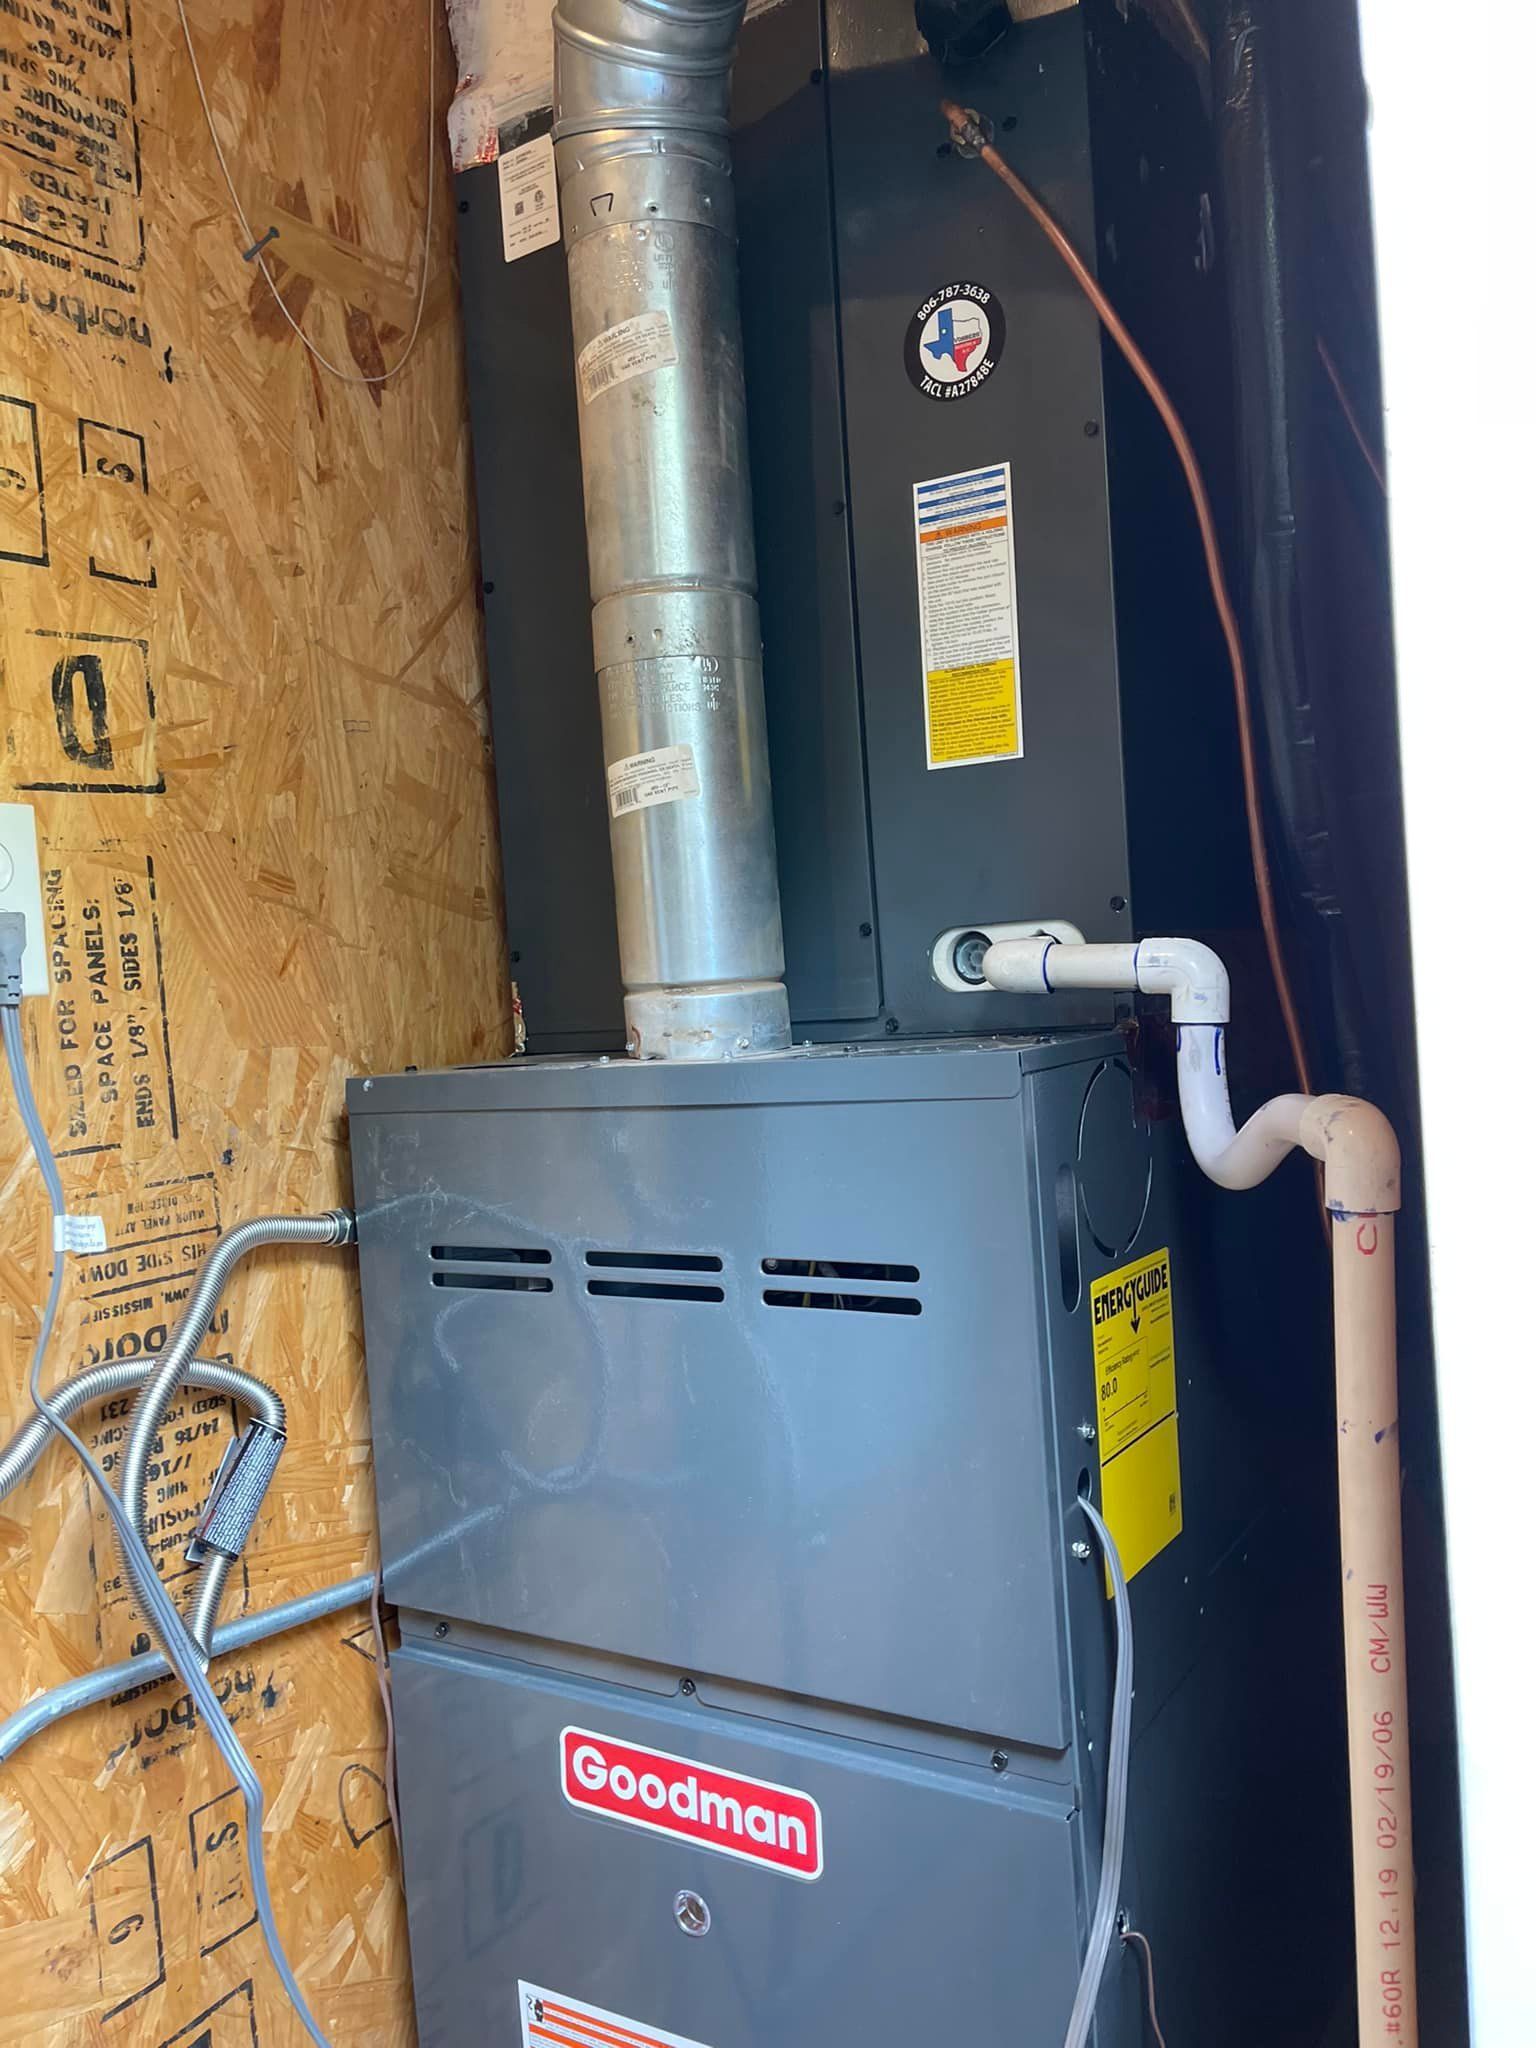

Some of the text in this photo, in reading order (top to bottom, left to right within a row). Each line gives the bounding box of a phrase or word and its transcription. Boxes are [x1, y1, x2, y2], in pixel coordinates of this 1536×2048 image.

[917, 284, 991, 321] 806-787-3638
[920, 358, 995, 398] TACL #A27848E
[120, 932, 142, 992] SIDES
[56, 1000, 80, 1050] FOR
[93, 1020, 119, 1104] SPACE
[133, 1073, 155, 1129] ENDS
[182, 1243, 207, 1262] HIS
[1101, 1377, 1119, 1401] 80.0
[571, 1745, 808, 1856] Goodman
[1373, 1709, 1398, 1851] 02/19/06
[1378, 1868, 1402, 1952] 12.19
